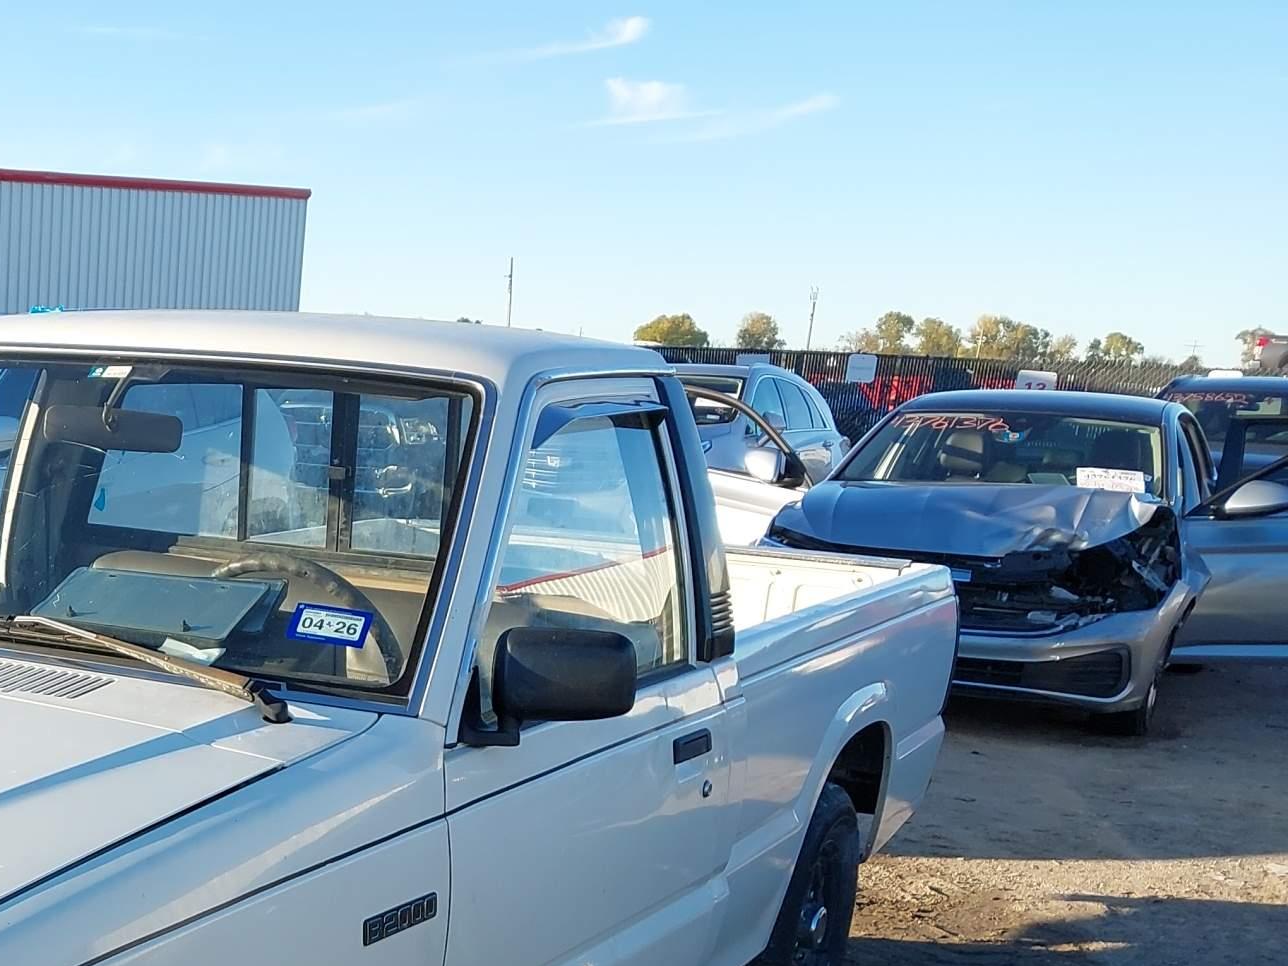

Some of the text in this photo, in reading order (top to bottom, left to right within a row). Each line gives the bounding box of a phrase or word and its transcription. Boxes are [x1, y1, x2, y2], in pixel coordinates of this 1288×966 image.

[301, 616, 359, 636] 04 26
[366, 894, 436, 945] B2000
